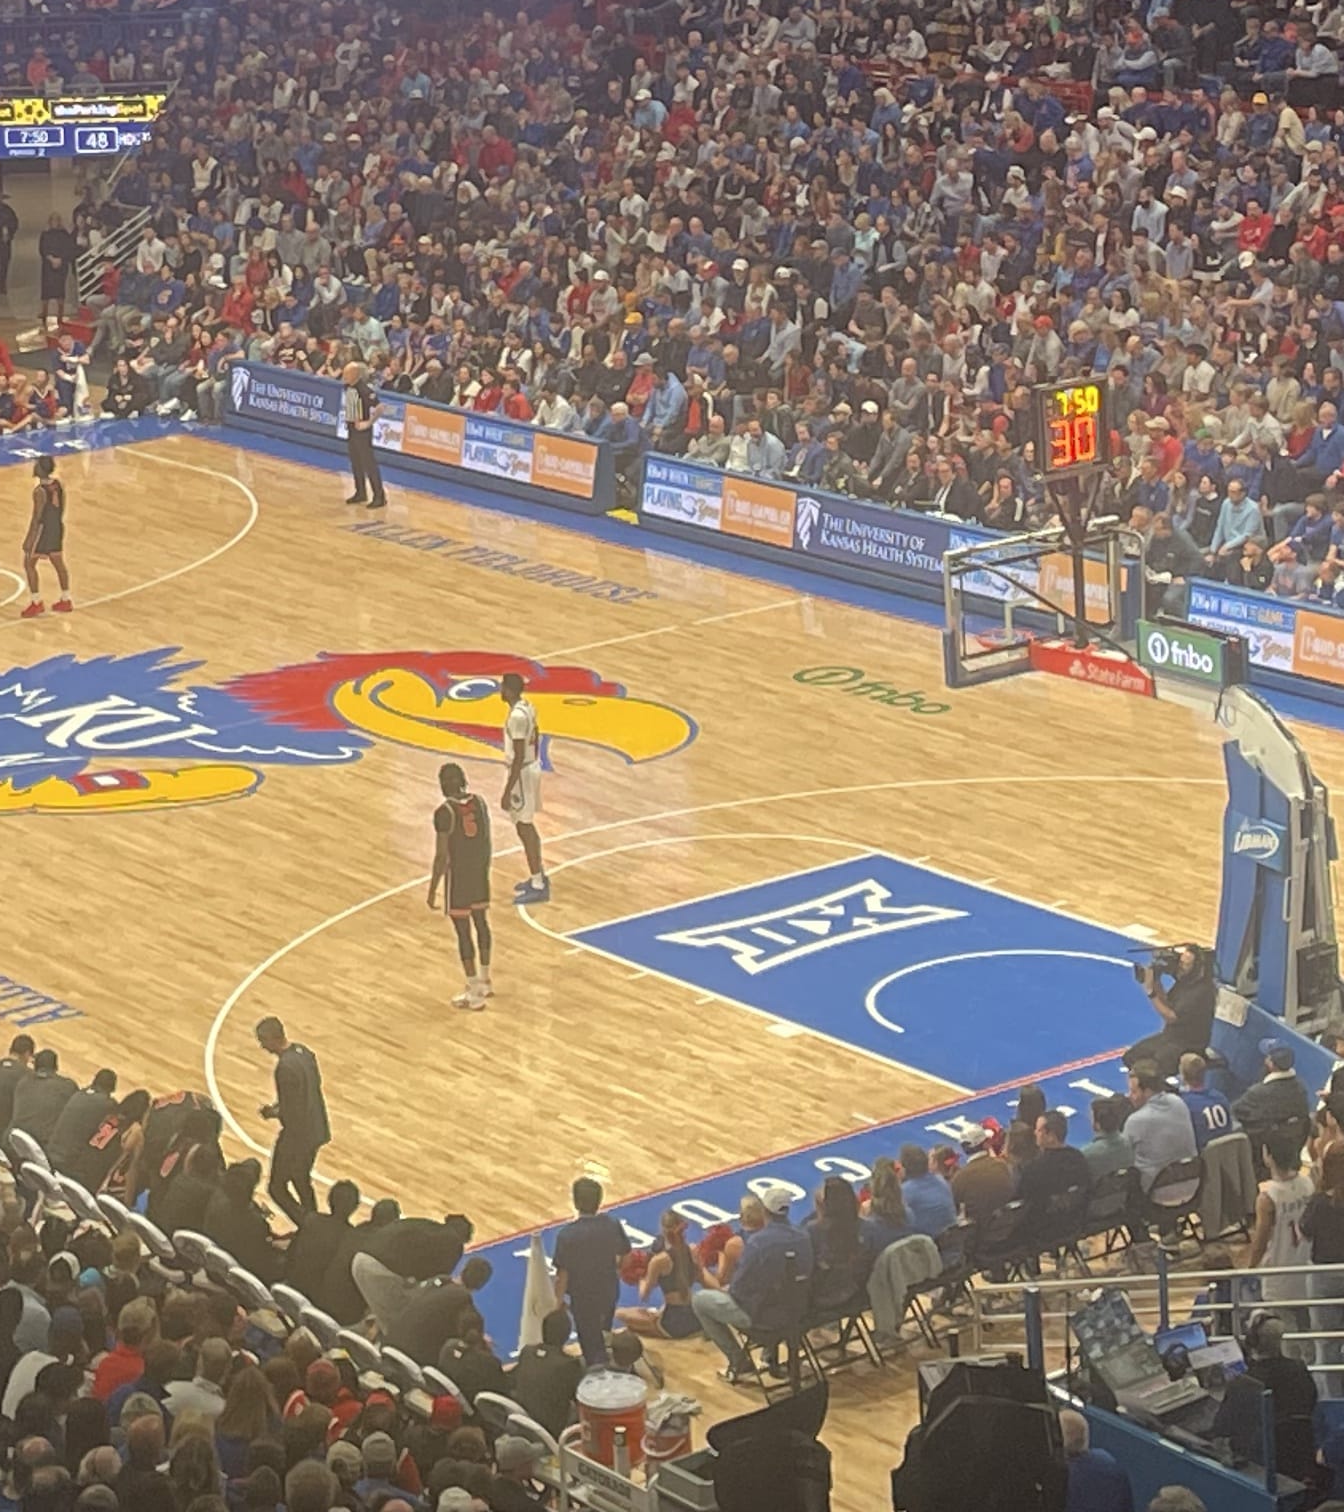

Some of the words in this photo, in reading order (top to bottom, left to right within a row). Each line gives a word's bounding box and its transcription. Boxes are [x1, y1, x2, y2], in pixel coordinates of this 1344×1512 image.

[85, 133, 109, 149] 48
[1050, 416, 1096, 466] 30
[820, 529, 861, 554] KANSAS
[862, 542, 904, 564] HEALTH
[822, 512, 844, 533] THE
[845, 519, 906, 546] UNIVERSITY
[909, 537, 926, 552] OF
[1220, 598, 1248, 619] WHEN
[1171, 639, 1215, 674] fnbo
[841, 681, 951, 715] fnbo
[13, 693, 219, 750] KU
[1204, 1104, 1228, 1130] 10
